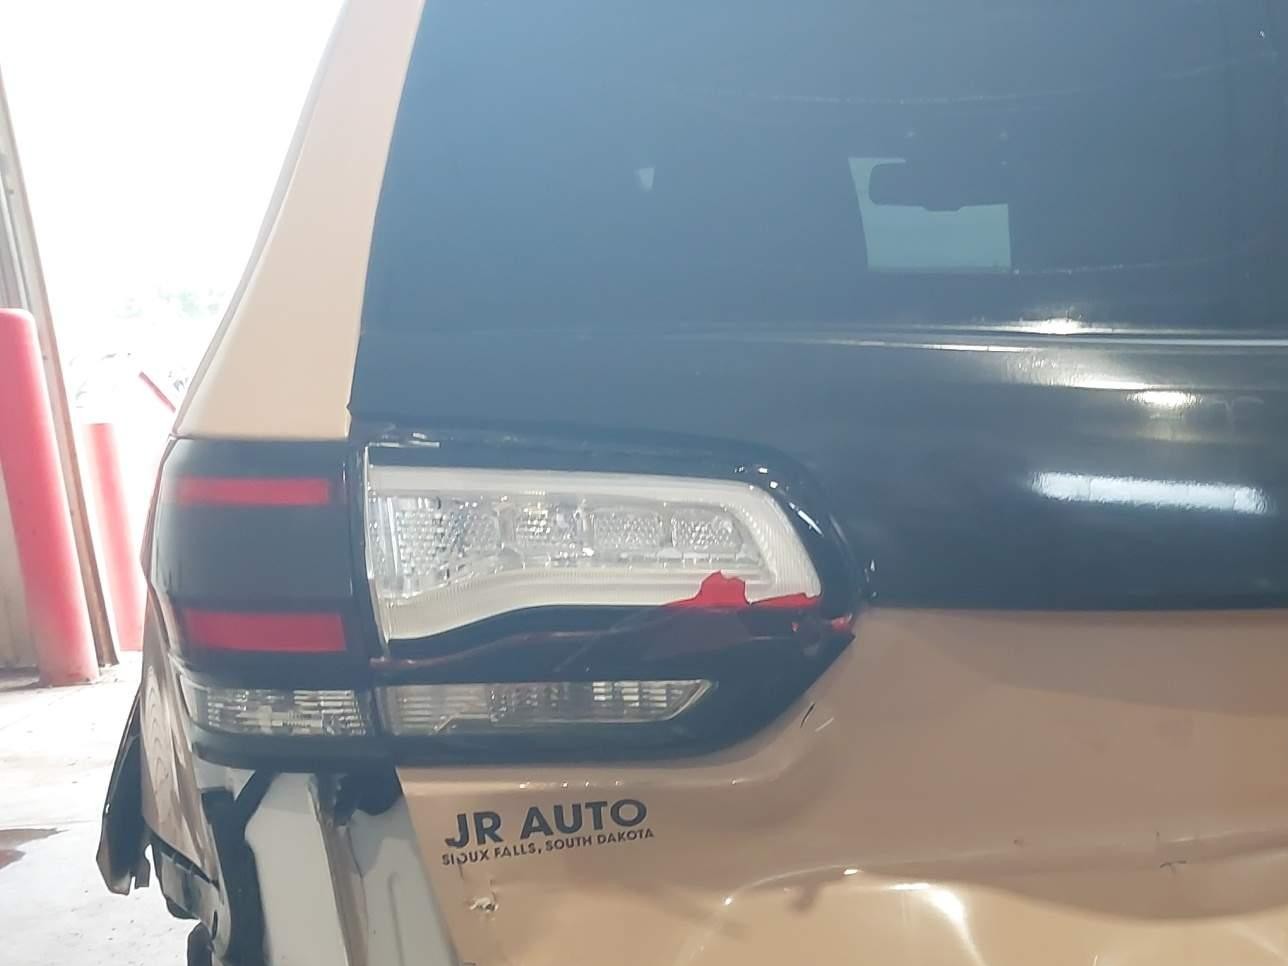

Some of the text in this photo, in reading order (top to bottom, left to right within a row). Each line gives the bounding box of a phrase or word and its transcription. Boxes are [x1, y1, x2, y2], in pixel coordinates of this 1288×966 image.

[444, 799, 648, 849] JR AUTO
[442, 828, 655, 866] SIOUX FALLS, SOUTH DAKOTA
